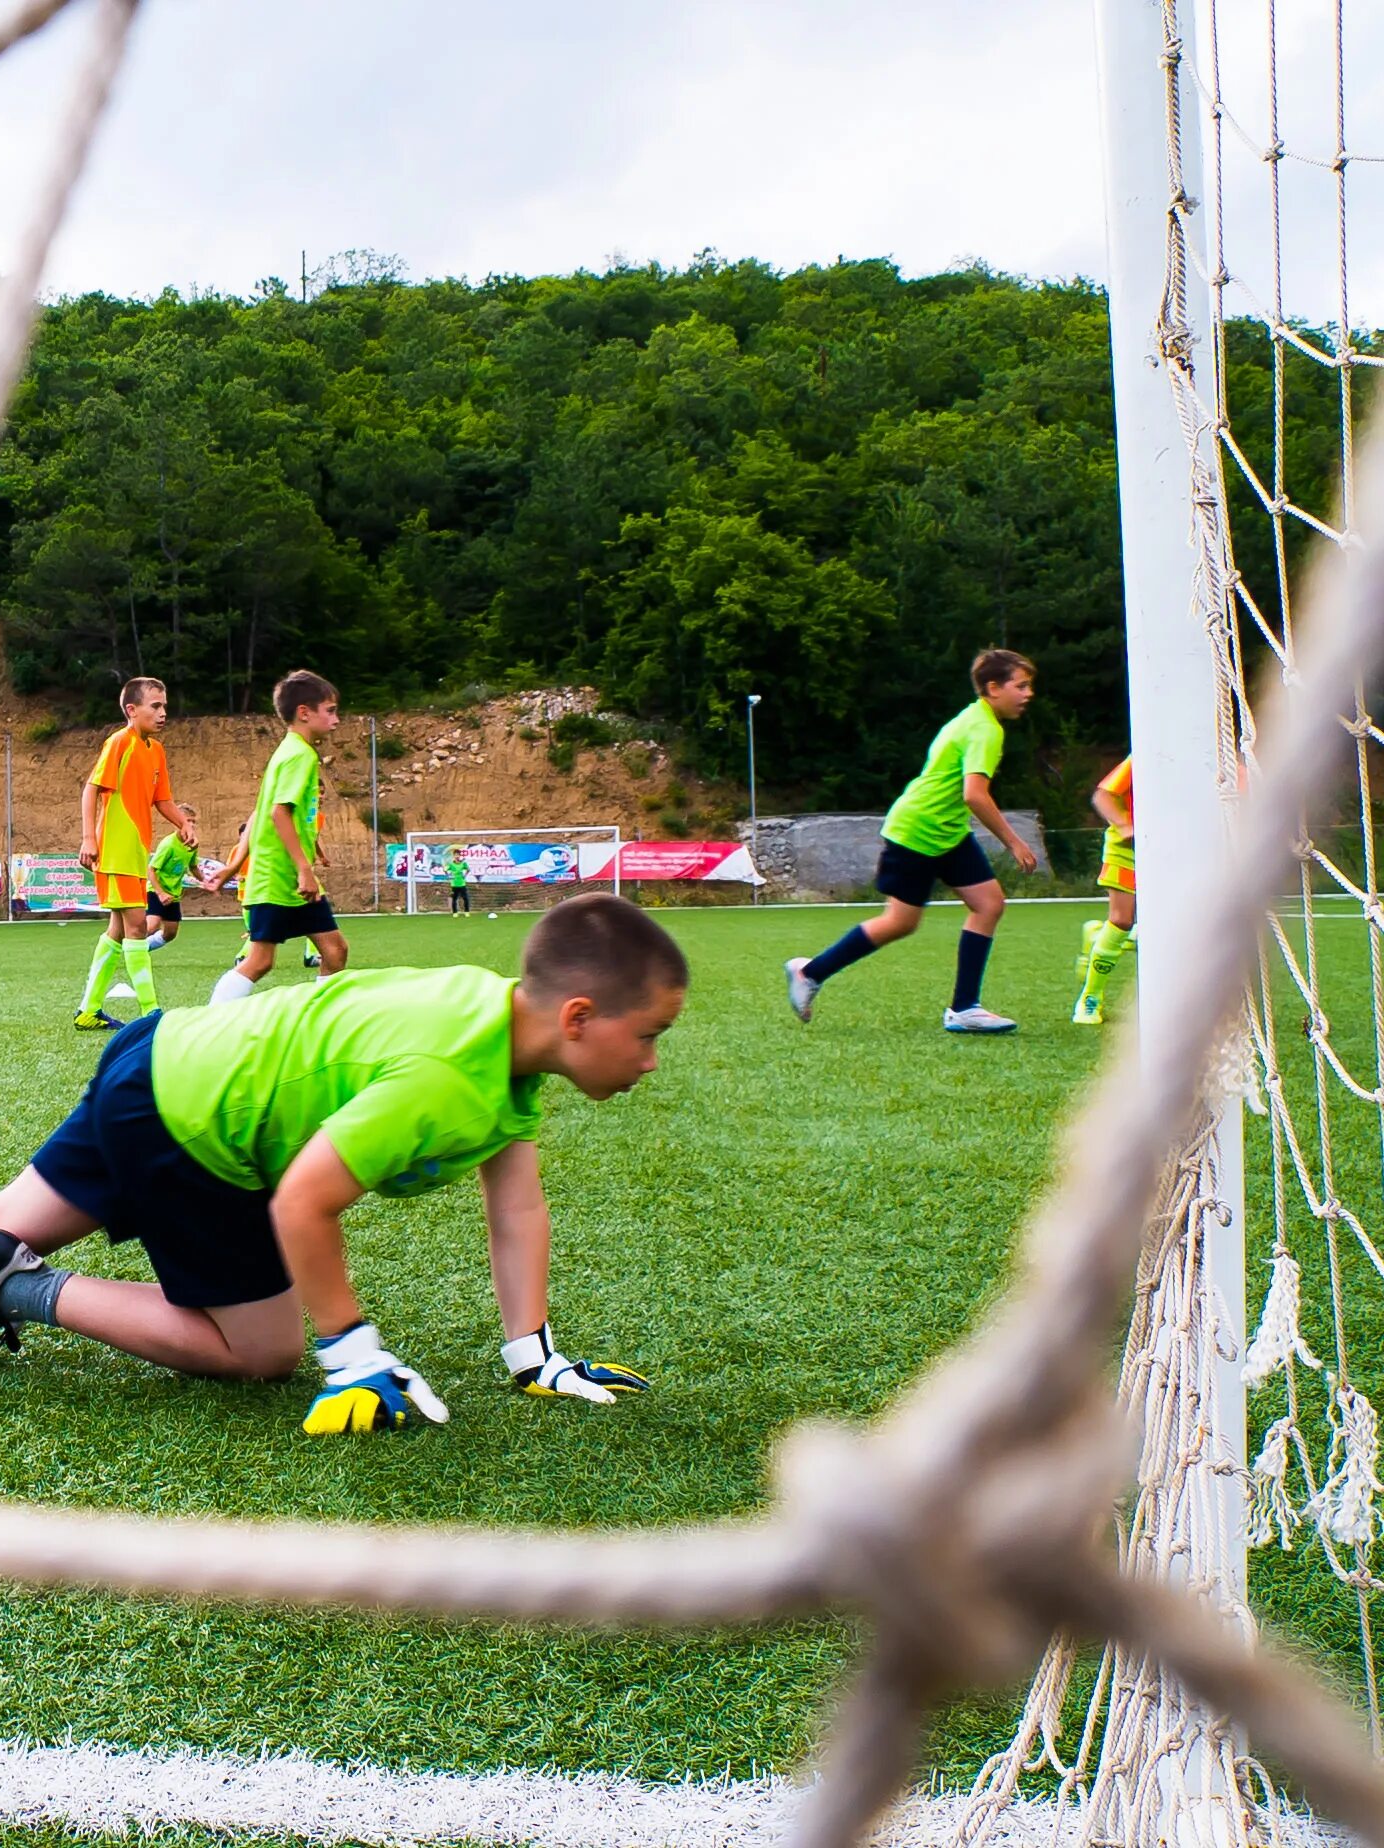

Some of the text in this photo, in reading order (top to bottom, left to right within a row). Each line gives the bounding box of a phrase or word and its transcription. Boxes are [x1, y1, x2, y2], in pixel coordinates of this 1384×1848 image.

[459, 849, 508, 858] ФИНАЛ
[26, 859, 79, 868] Вас приветс
